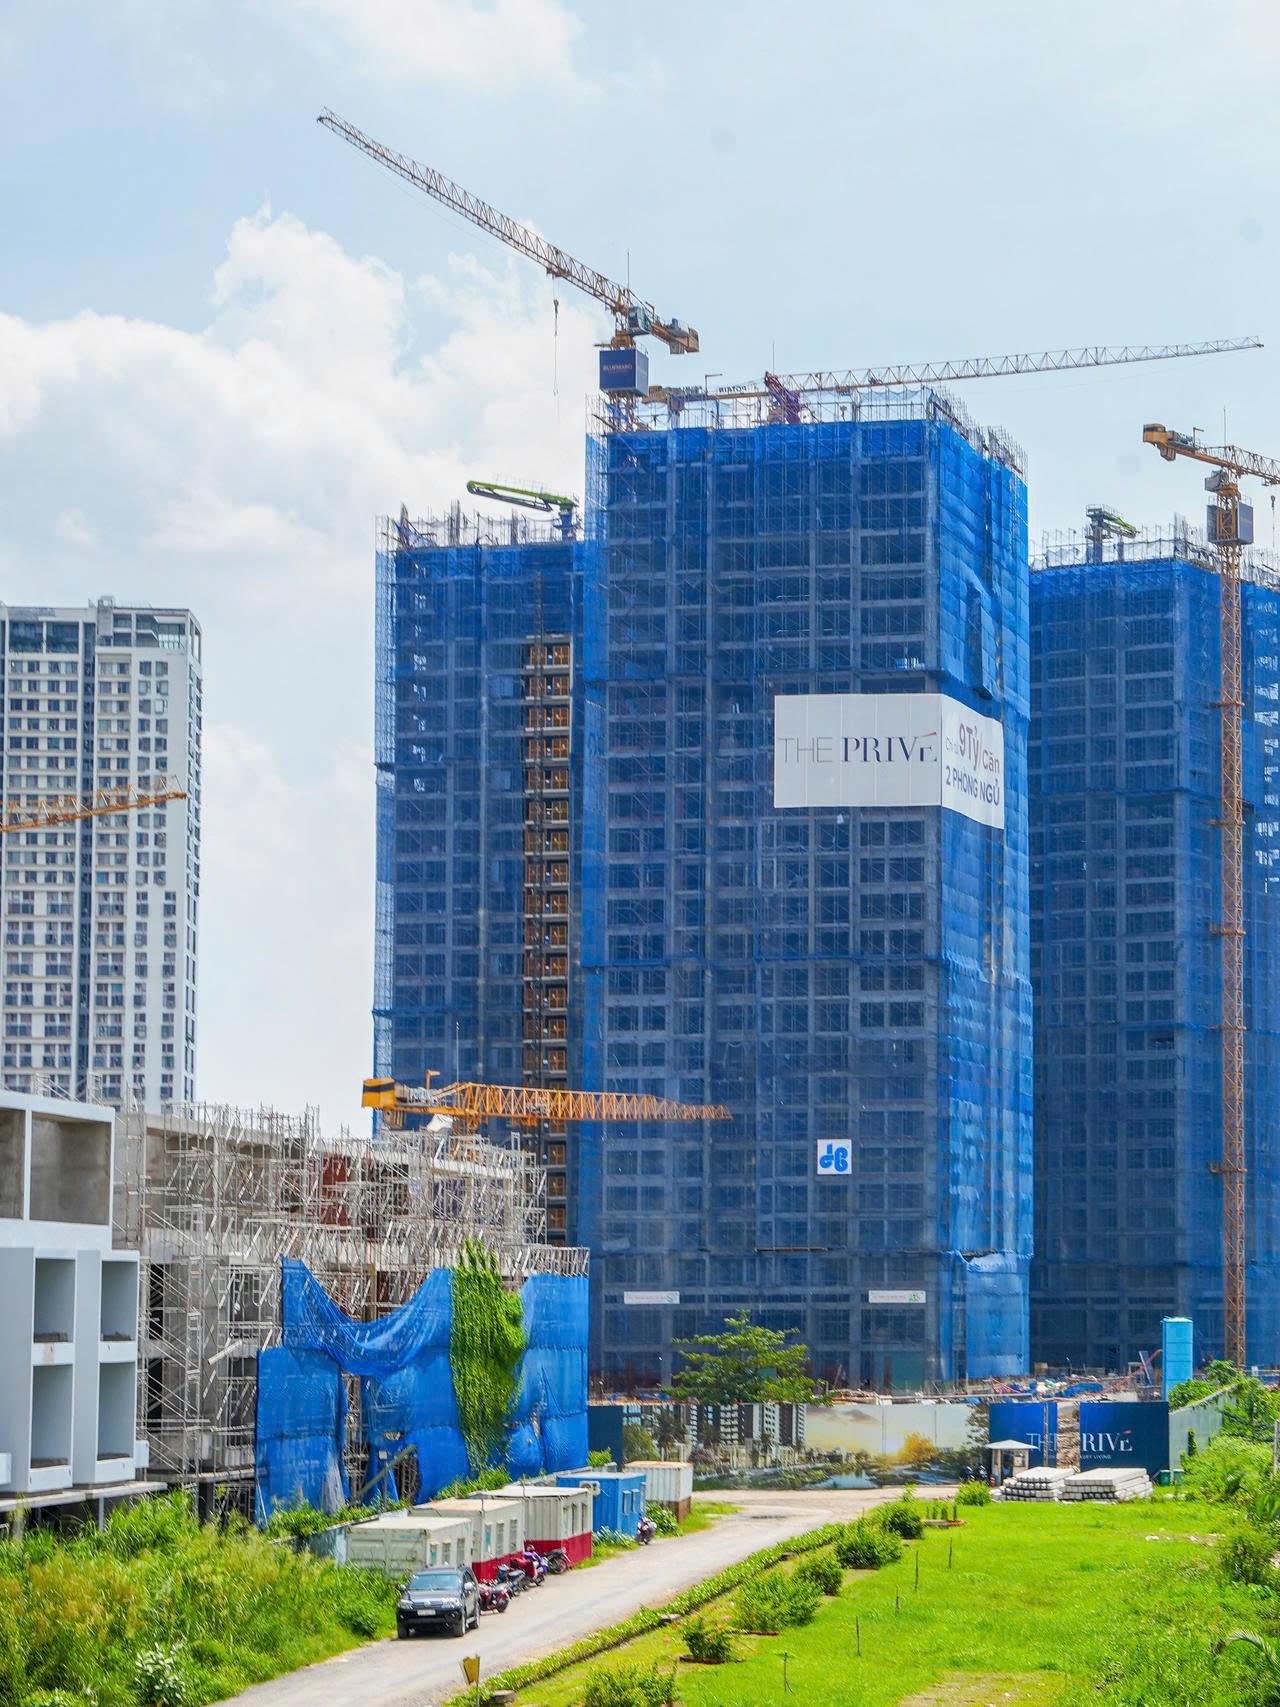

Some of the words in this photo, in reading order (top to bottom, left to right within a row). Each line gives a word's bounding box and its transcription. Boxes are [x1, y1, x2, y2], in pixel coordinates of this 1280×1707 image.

[778, 737, 833, 763] THE
[842, 731, 938, 763] PRIVÉ
[946, 766, 951, 785] 2
